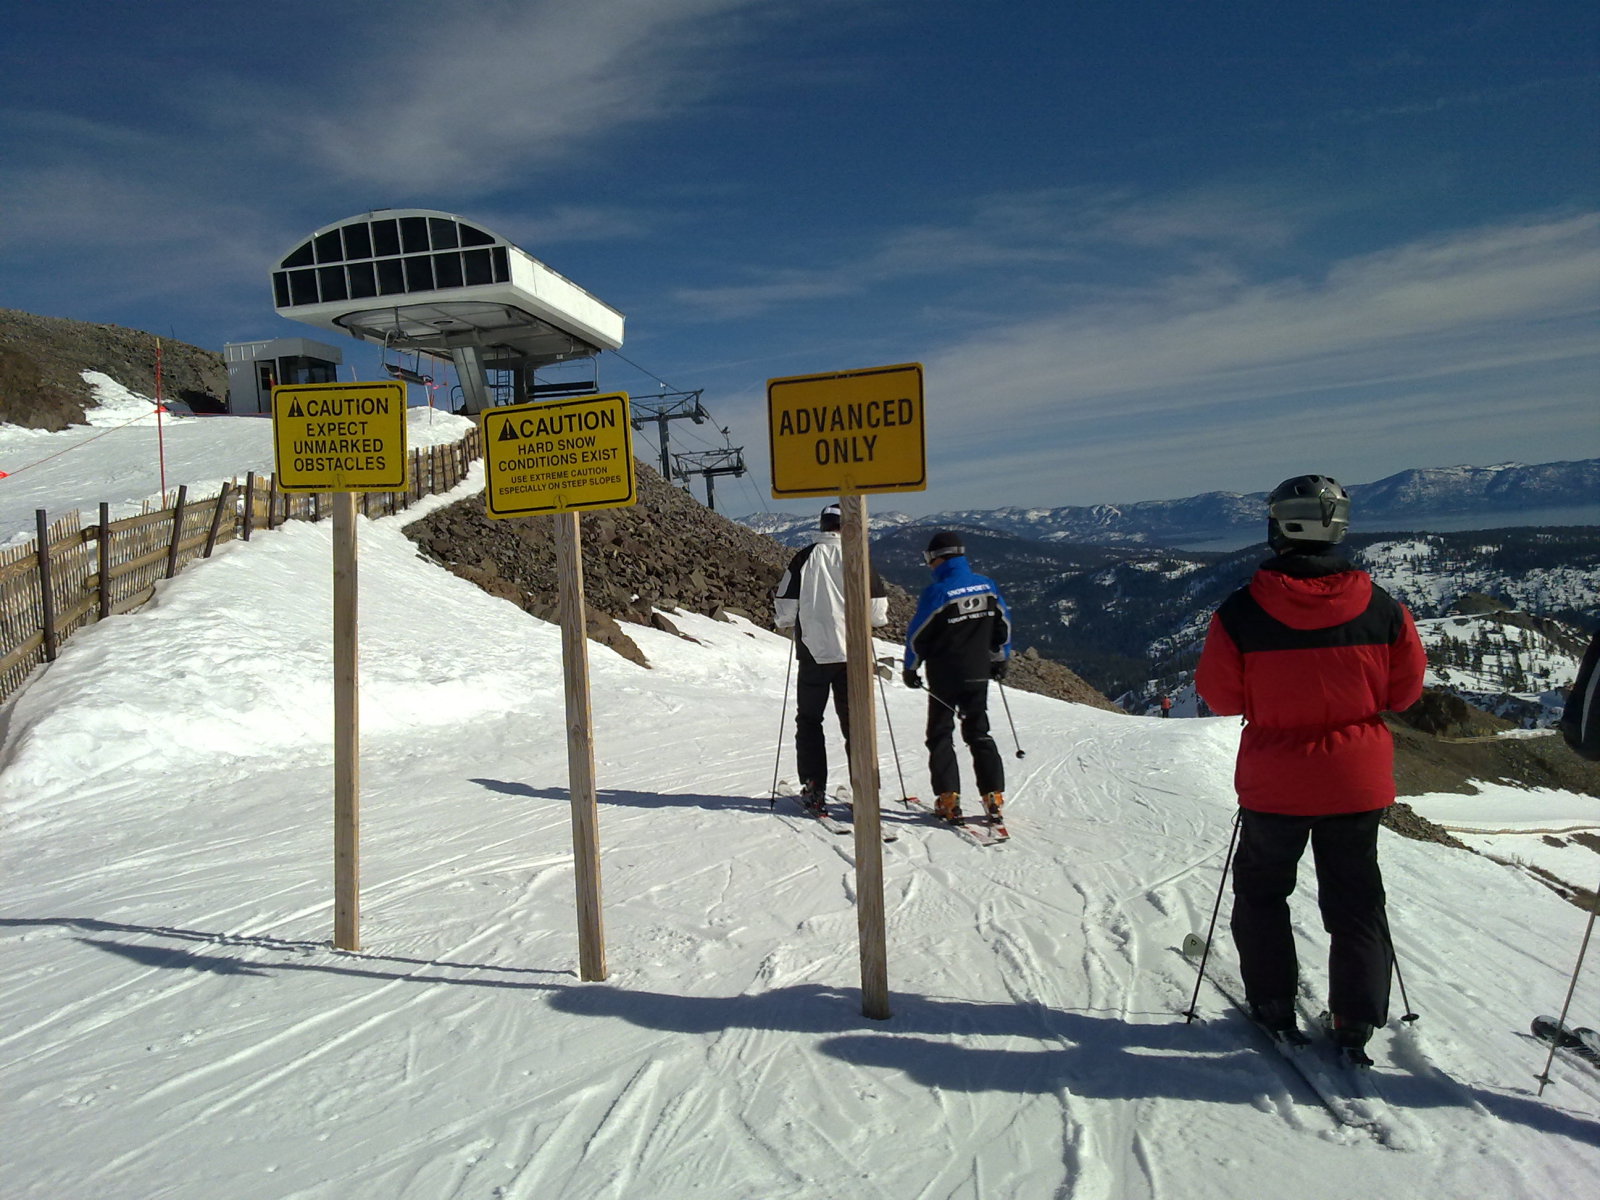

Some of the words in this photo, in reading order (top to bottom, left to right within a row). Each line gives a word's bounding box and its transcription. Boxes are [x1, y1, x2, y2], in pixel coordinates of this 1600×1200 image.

[306, 397, 390, 417] CAUTION
[519, 409, 616, 438] CAUTION
[779, 398, 914, 437] ADVANCED
[306, 421, 368, 437] EXPECT
[293, 438, 384, 455] UNMARKED
[517, 440, 554, 455] HARD
[557, 436, 597, 451] SNOW
[815, 435, 878, 466] ONLY
[293, 456, 386, 472] OBSTACLES
[498, 452, 578, 472] CONDITIONS
[581, 448, 618, 463] EXIST
[499, 481, 547, 496] ESPECIALLY
[548, 480, 561, 491] ON
[562, 477, 589, 489] STEEP
[590, 474, 622, 486] SLOPES
[510, 474, 528, 484] USE
[530, 470, 569, 482] EXTREME
[571, 466, 608, 478] CAUTION
